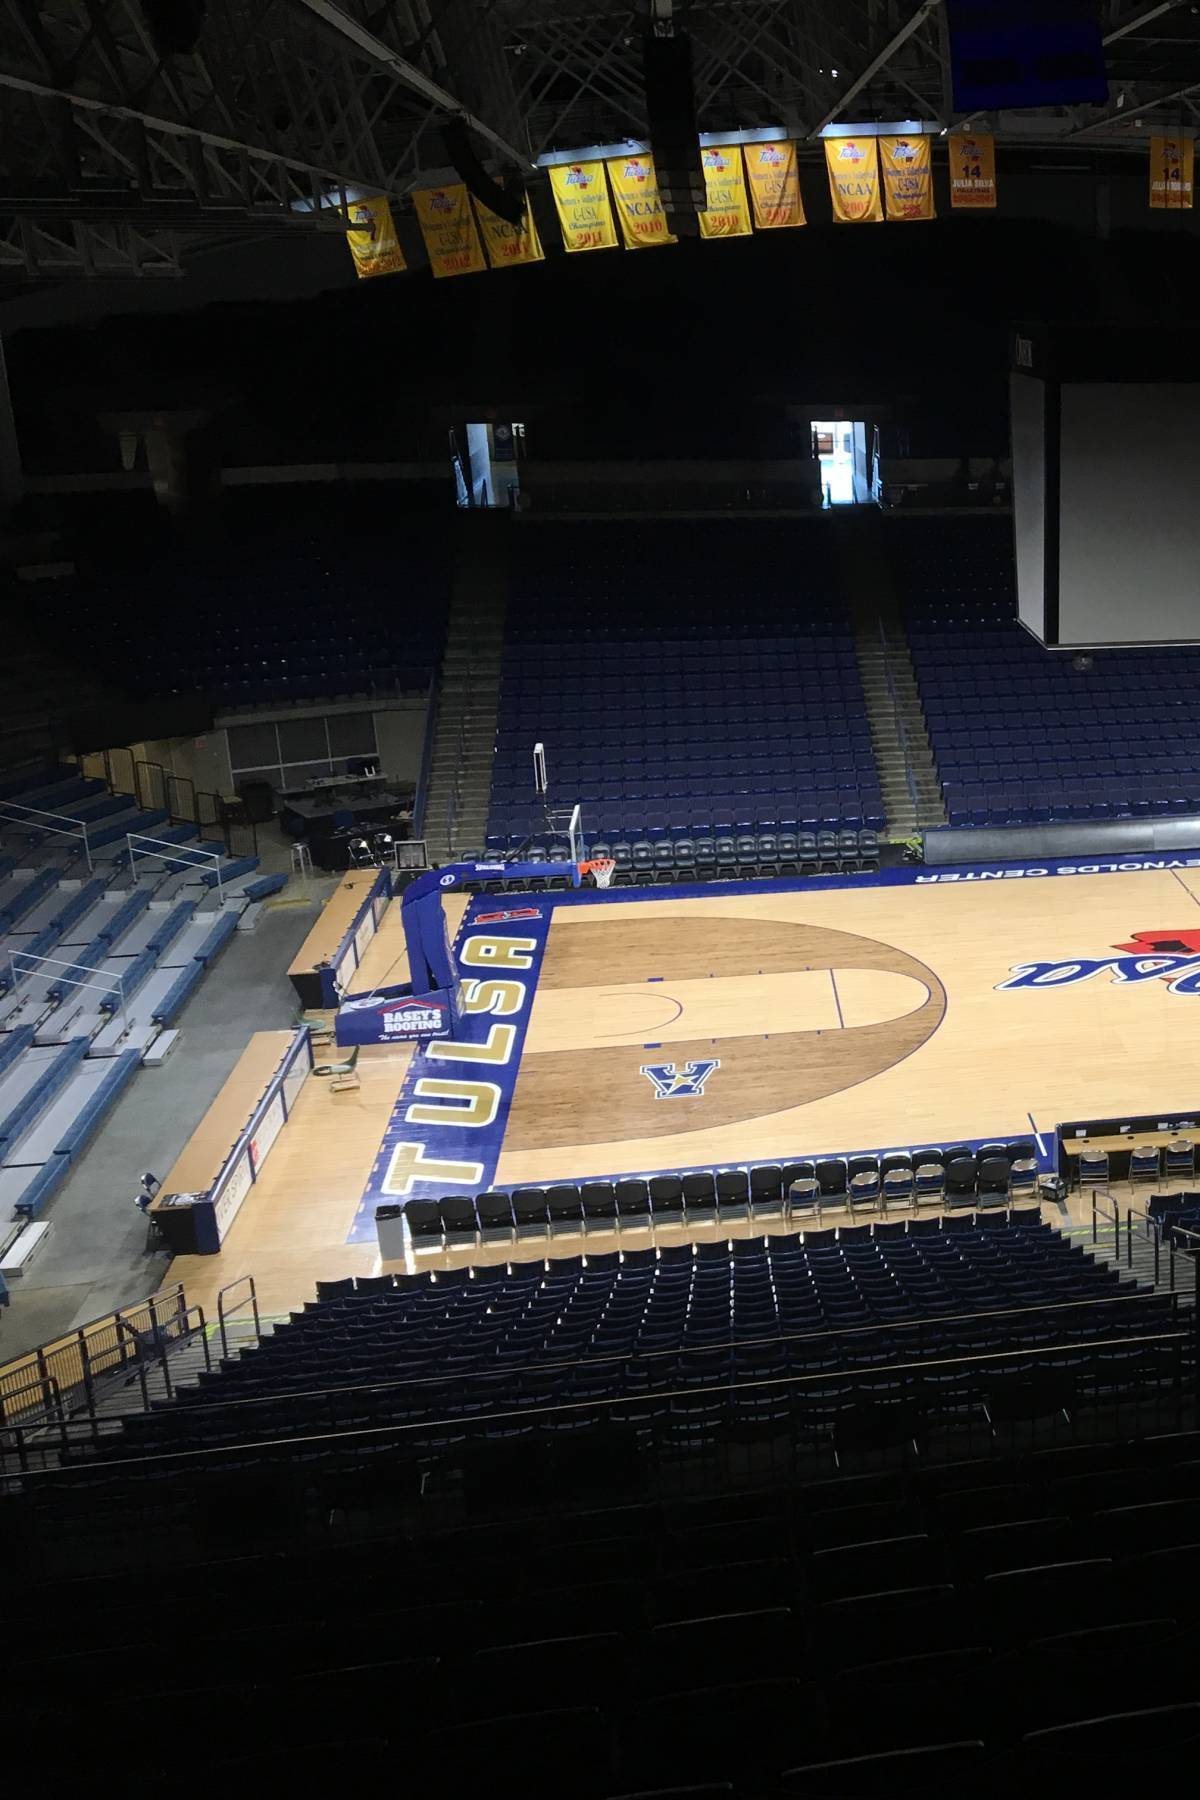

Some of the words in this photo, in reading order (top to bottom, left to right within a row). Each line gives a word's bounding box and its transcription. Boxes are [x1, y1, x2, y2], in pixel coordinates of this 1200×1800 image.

[962, 165, 982, 178] 14
[1163, 168, 1180, 181] 14
[838, 183, 873, 196] NCAA
[953, 179, 973, 188] JULIA
[975, 179, 994, 188] SILVA
[626, 201, 662, 217] NCAA
[914, 867, 1049, 884] CENTER
[383, 1009, 441, 1023] BASEY'S
[384, 1020, 442, 1033] ROOFING
[381, 935, 538, 1195] TULSA
